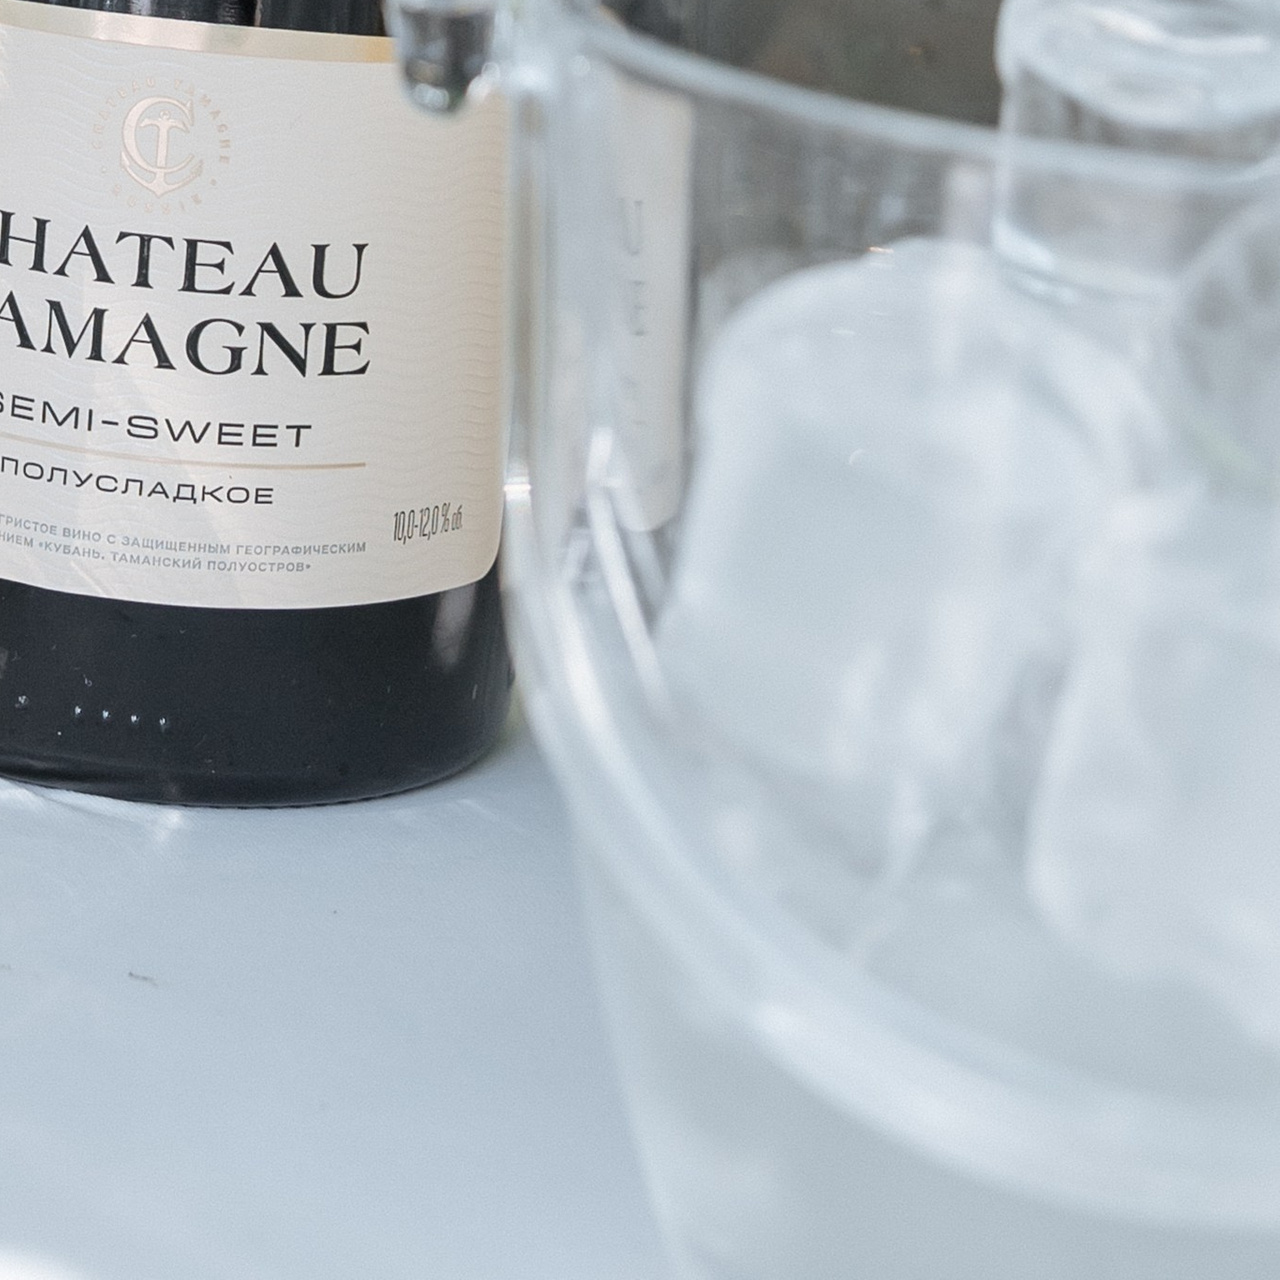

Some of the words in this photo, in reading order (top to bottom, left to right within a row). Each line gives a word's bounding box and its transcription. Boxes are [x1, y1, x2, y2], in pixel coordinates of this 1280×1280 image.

[0, 456, 275, 505] ПОЛУСЛАДКОЕ
[61, 526, 102, 544] ВИНО
[106, 534, 116, 545] С
[120, 535, 231, 556] ЗАЩИЩЕННЫМ
[235, 541, 367, 557] ГЕОГРАФИЧЕСКИМ
[110, 550, 202, 570] ТАМАНСКИЙ
[207, 559, 312, 573] ПОЛУОСТРОВ»
